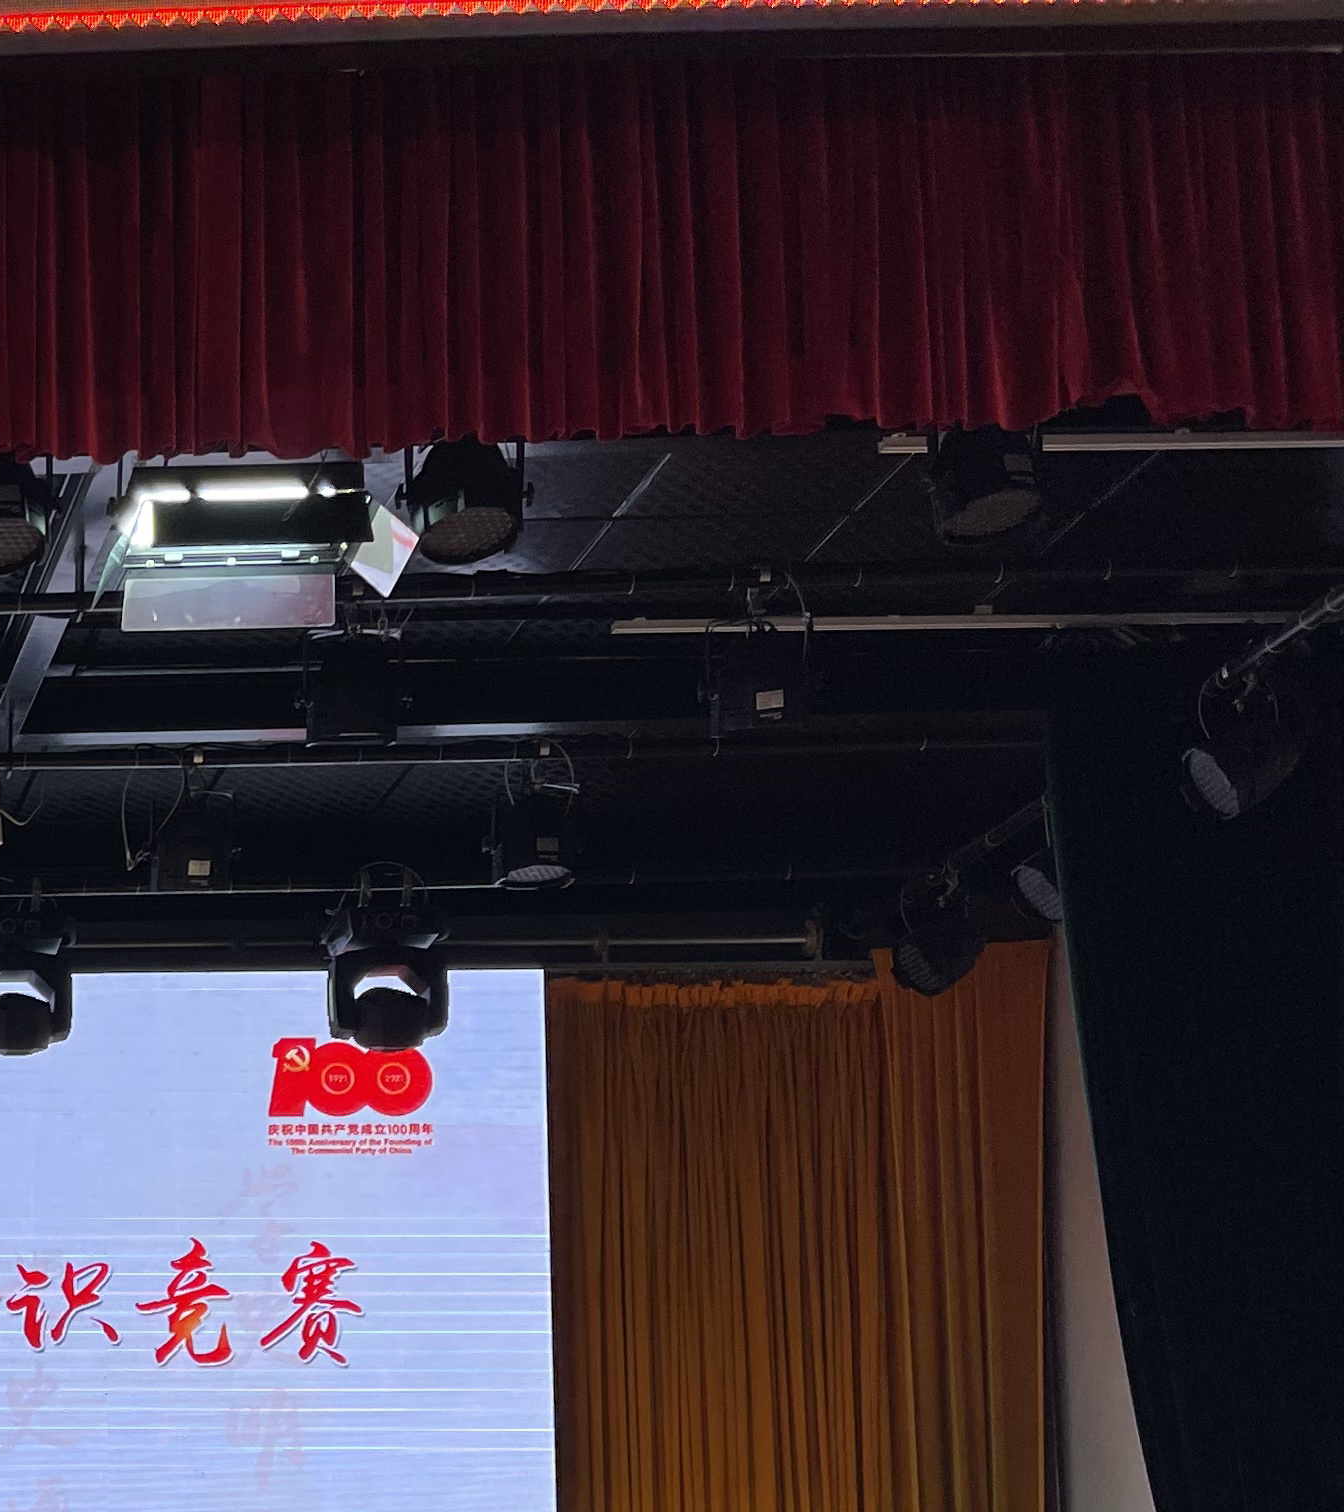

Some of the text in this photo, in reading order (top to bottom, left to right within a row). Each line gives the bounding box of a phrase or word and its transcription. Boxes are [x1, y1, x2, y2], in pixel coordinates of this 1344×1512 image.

[267, 1123, 433, 1136] 庆祝中国共产党成立100周年
